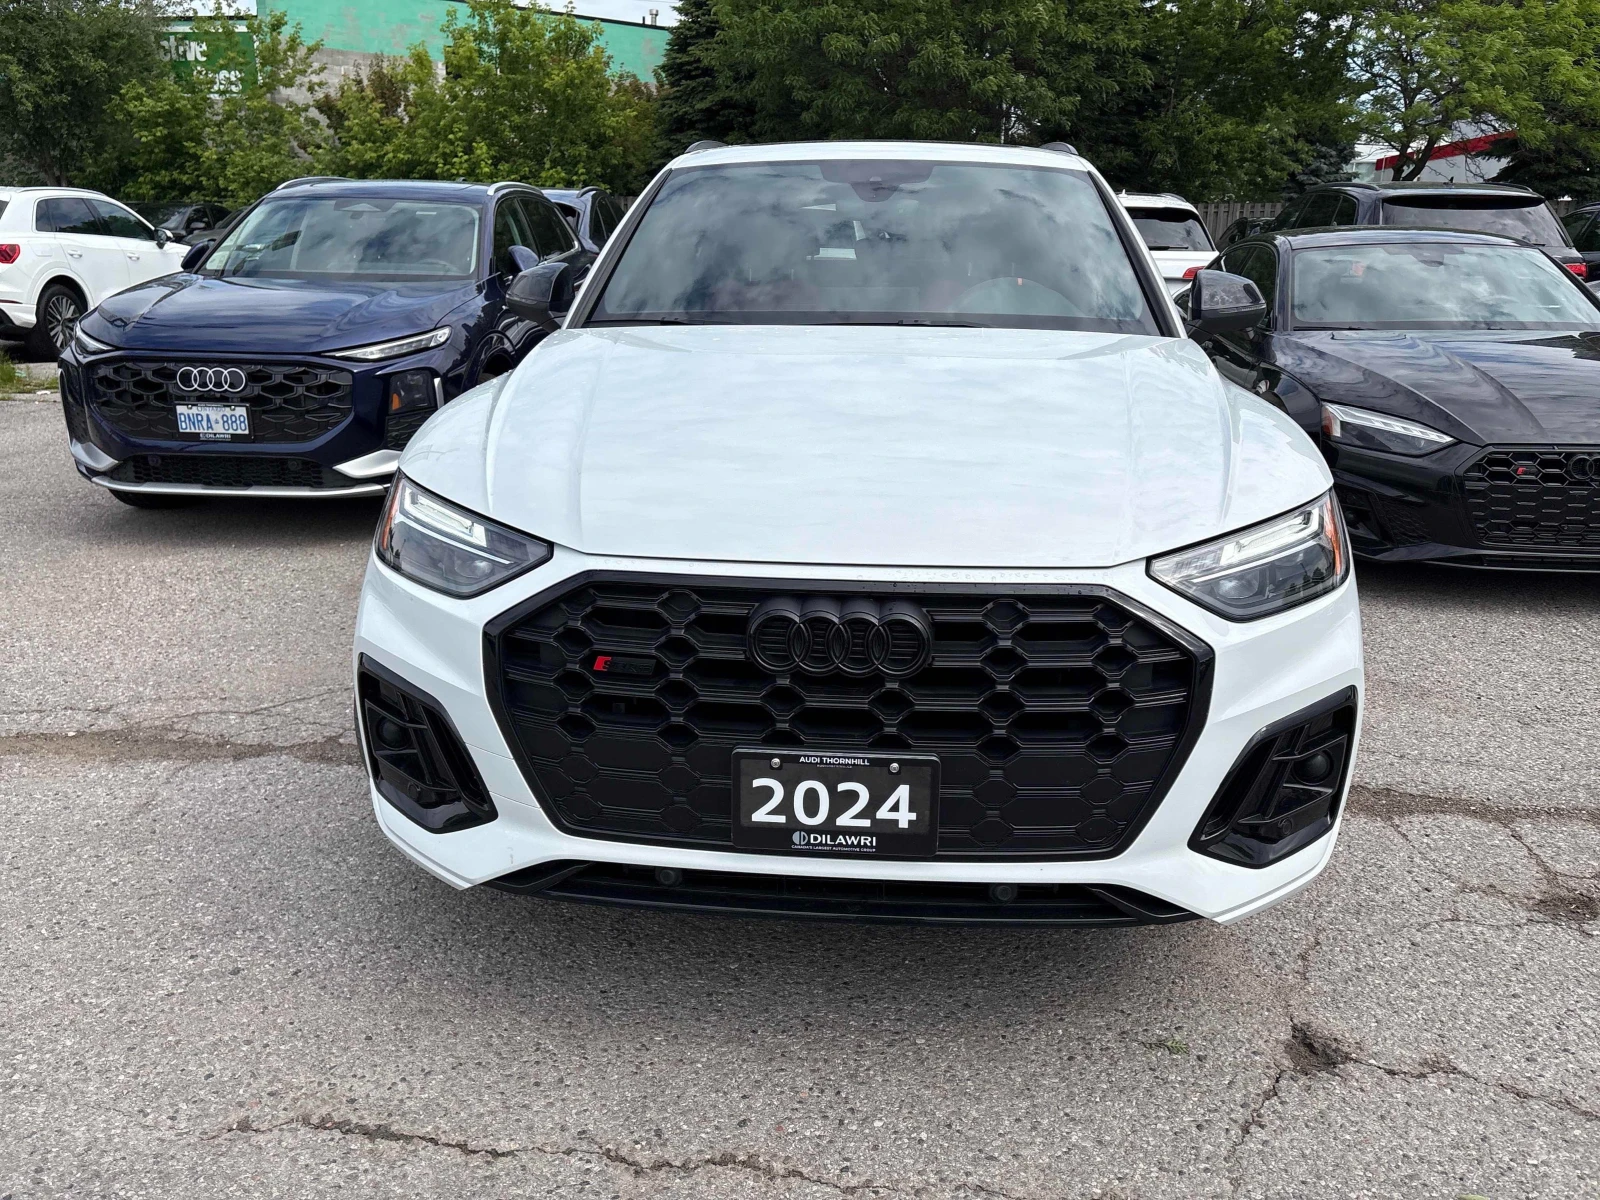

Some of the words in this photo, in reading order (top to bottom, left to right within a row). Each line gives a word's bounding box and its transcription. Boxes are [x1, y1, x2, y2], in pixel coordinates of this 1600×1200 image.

[160, 35, 208, 62] ctive
[178, 412, 214, 431] BNRA
[221, 413, 247, 432] 888
[799, 756, 820, 764] AUDI
[822, 757, 870, 766] THORNHILL
[751, 777, 917, 829] 2024
[810, 833, 877, 847] DILAWRI
